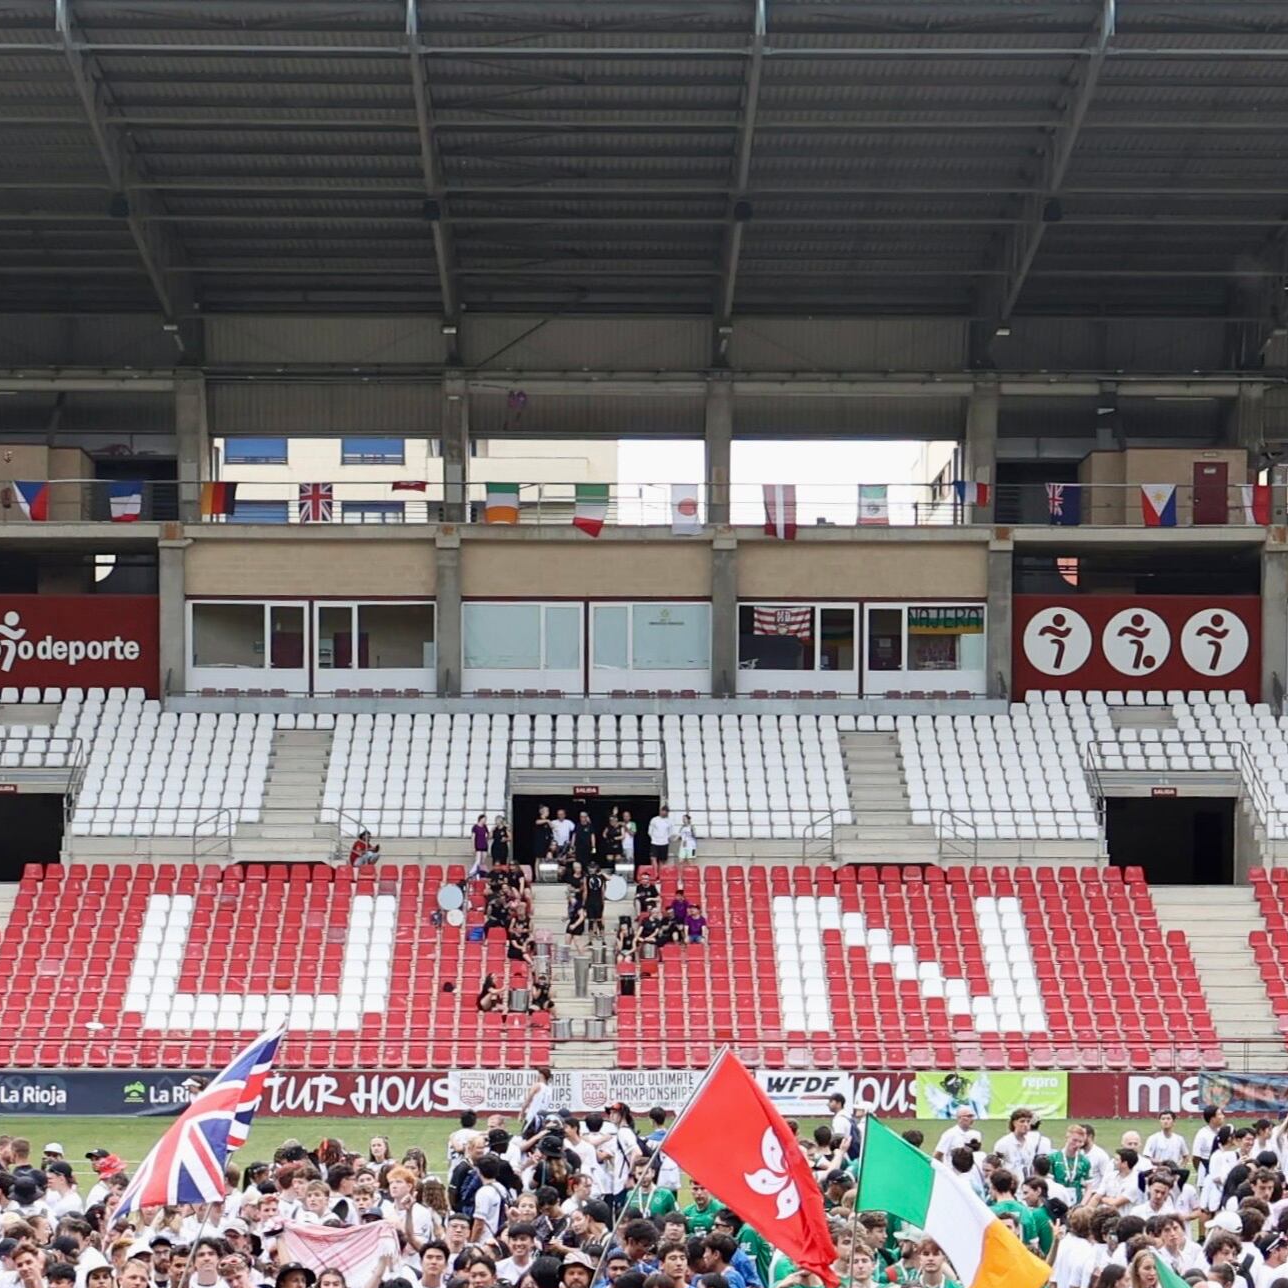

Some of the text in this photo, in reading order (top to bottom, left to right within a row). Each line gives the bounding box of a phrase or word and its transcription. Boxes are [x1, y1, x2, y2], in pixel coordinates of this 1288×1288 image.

[36, 635, 140, 666] deporte
[487, 1072, 524, 1086] WORLD
[609, 1072, 644, 1086] WORLD
[648, 1072, 694, 1086] ULTIMATE
[766, 1076, 840, 1093] WFDF
[0, 1086, 67, 1106] La Rioja
[149, 1086, 169, 1103] La
